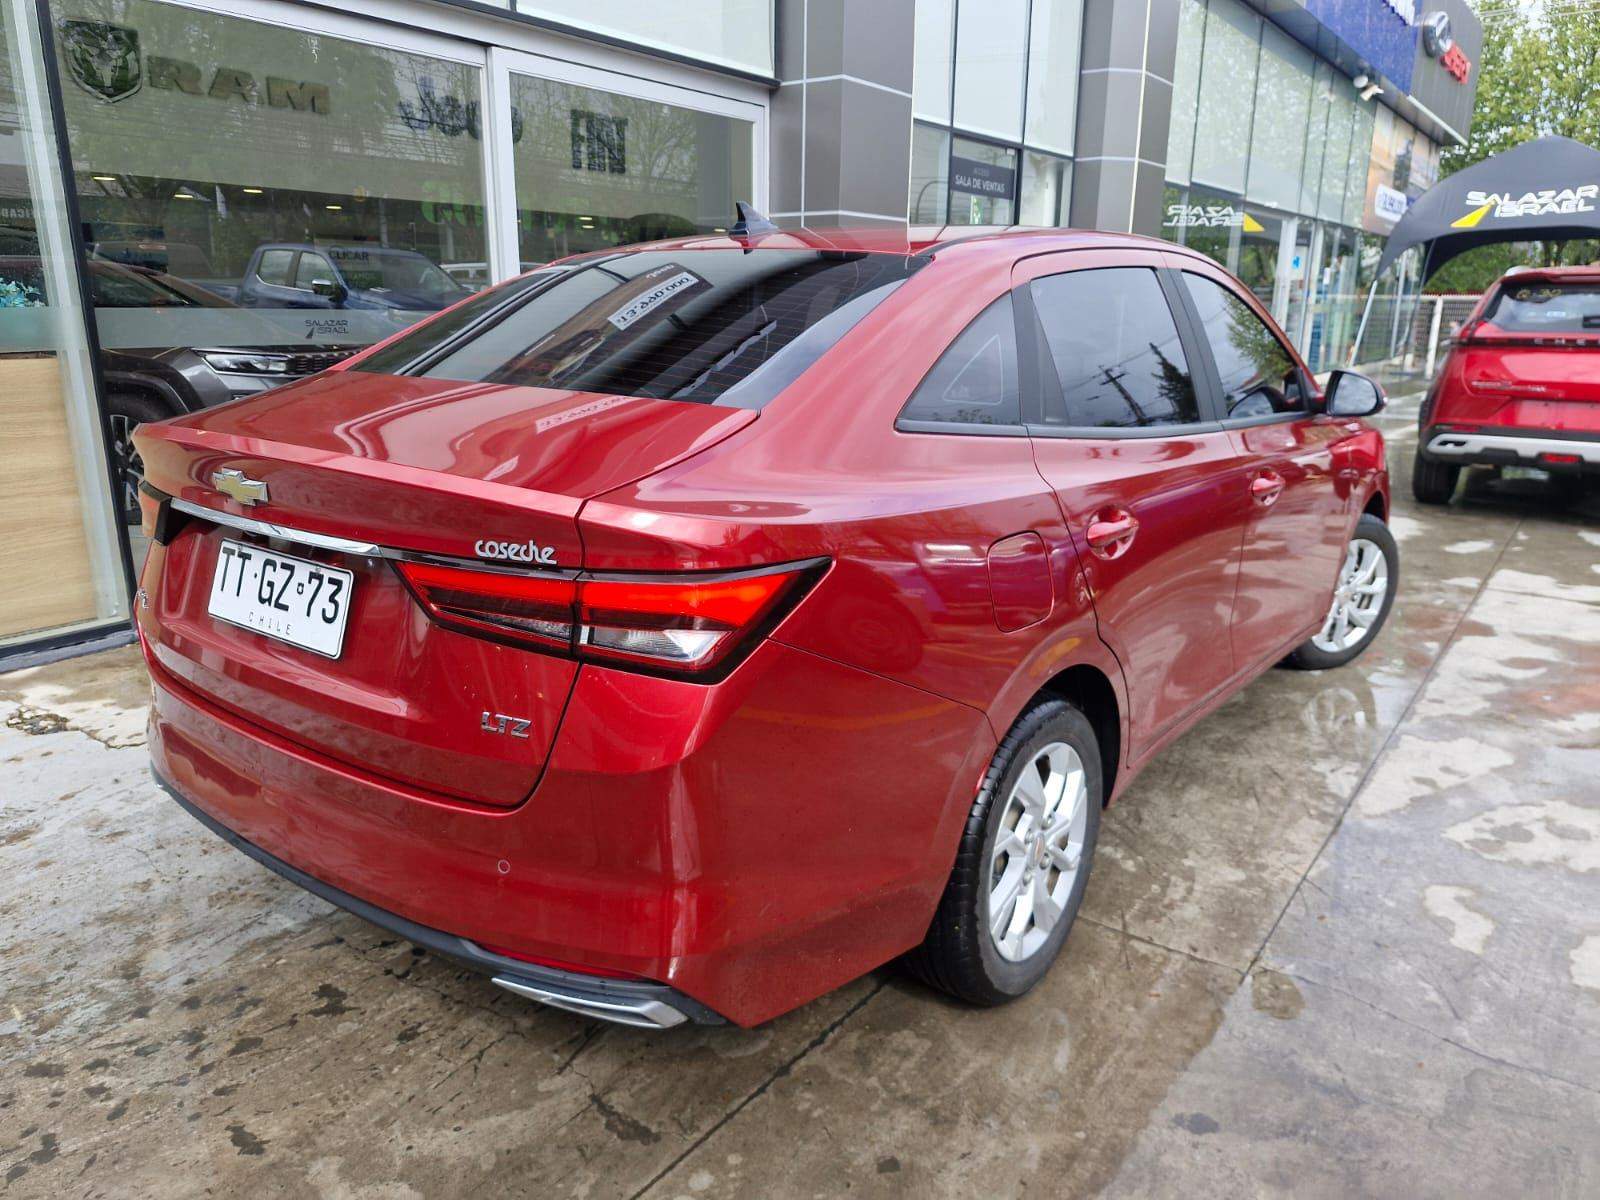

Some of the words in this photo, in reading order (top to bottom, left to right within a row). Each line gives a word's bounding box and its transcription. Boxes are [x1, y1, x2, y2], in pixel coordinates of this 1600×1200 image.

[147, 56, 330, 115] RAM
[955, 174, 971, 187] SALA
[972, 178, 982, 189] DE
[982, 180, 1006, 193] VENTAS
[1465, 184, 1600, 206] SALAZAR
[1493, 198, 1596, 218] ISRAEL
[304, 319, 349, 327] SALAZAR
[475, 540, 558, 565] coseche
[248, 611, 293, 635] CHILE
[481, 711, 532, 738] LTZ
